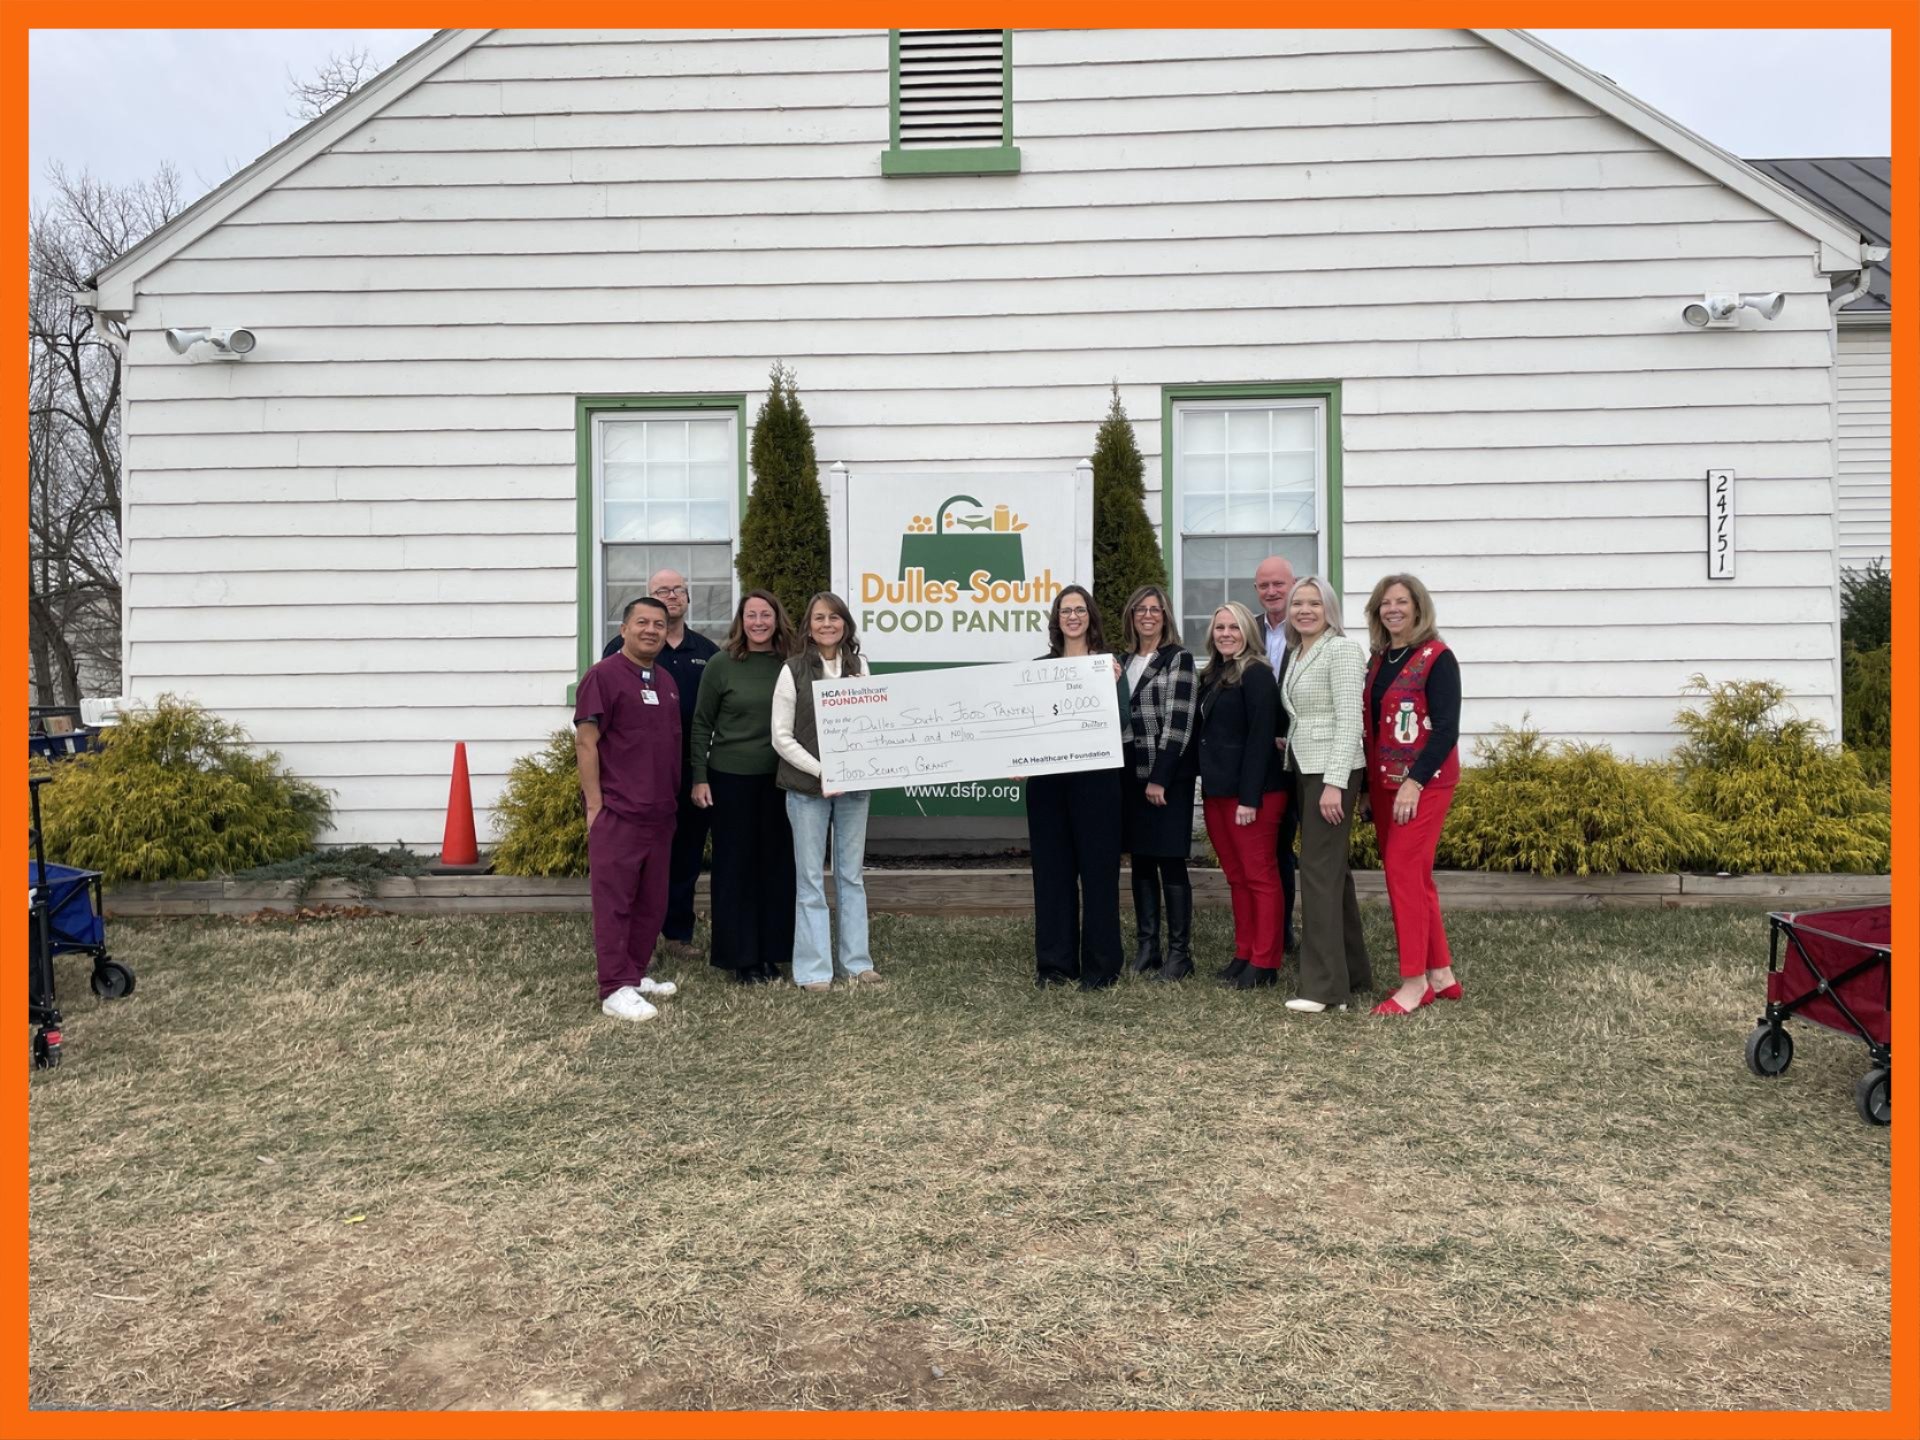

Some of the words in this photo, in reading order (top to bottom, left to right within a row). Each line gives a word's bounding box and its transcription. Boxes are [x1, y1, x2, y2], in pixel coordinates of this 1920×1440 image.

[1716, 475, 1728, 573] 24751
[861, 568, 959, 604] Dulles
[970, 568, 1063, 604] South
[862, 609, 944, 633] FOOD
[821, 689, 841, 698] HCA
[848, 686, 888, 696] Healthcare
[1066, 683, 1083, 691] Date
[821, 694, 888, 707] FOUNDATION
[854, 715, 895, 731] Dulles
[900, 707, 944, 726] South
[1081, 720, 1107, 729] Dollars
[867, 732, 917, 746] thousand
[924, 732, 943, 744] and
[1012, 757, 1029, 765] HCA
[1030, 754, 1069, 763] Healthcare
[1070, 750, 1111, 759] Foundation
[904, 782, 1020, 802] www.dsfp.org
